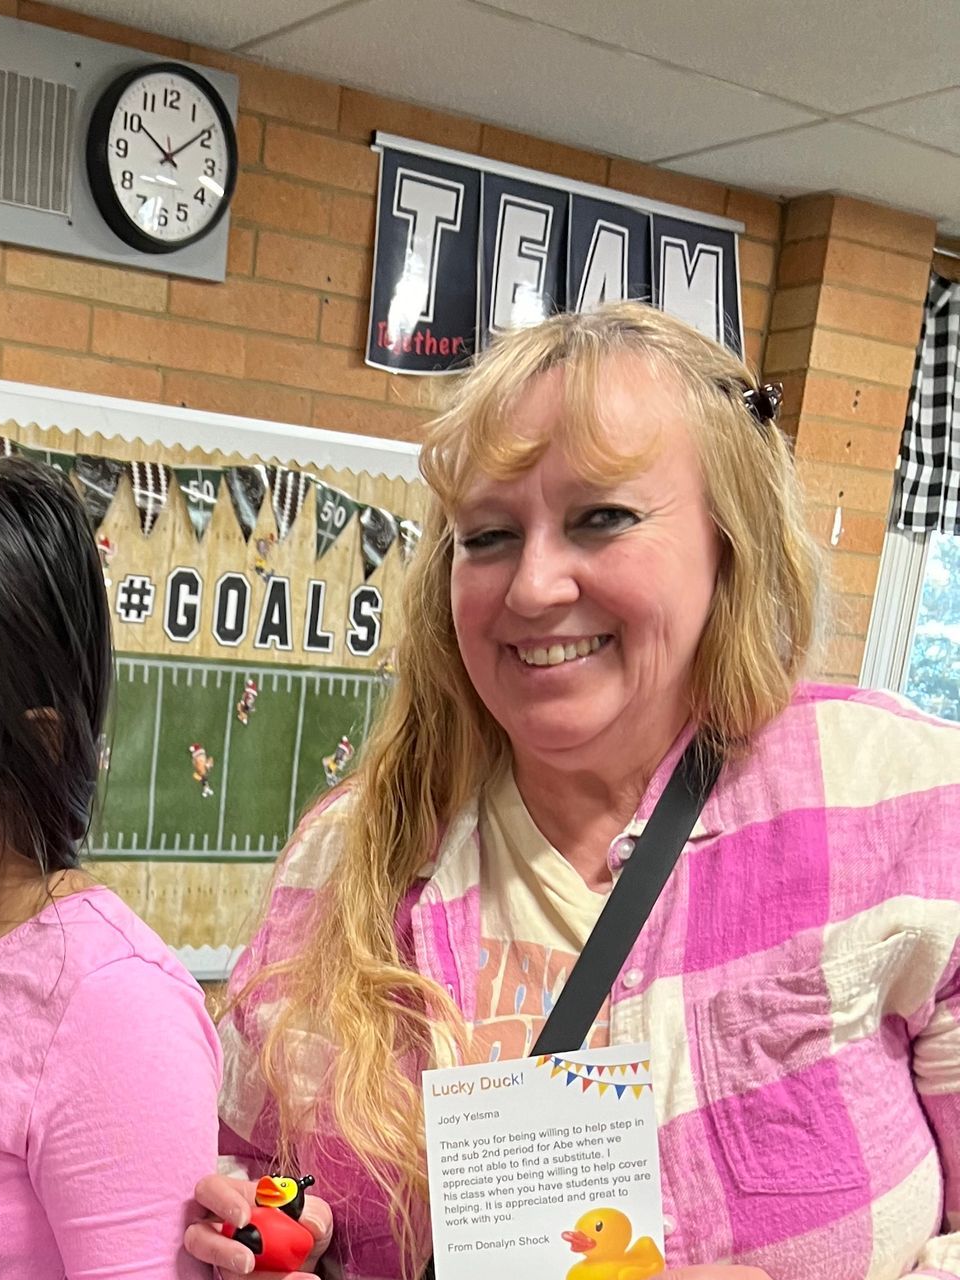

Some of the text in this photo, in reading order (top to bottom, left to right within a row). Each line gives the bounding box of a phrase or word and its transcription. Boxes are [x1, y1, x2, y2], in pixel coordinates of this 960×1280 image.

[143, 91, 156, 113] 11
[163, 88, 181, 110] 12
[124, 111, 142, 134] 10
[191, 103, 196, 123] 1
[115, 138, 128, 159] 9
[200, 128, 212, 149] 2
[203, 158, 216, 178] 3
[121, 170, 134, 190] 8
[193, 187, 206, 206] 4
[158, 208, 169, 227] 6
[176, 202, 188, 222] 5
[392, 166, 724, 348] TEAM
[188, 479, 215, 504] 50
[320, 502, 346, 528] 50
[114, 566, 382, 657] #GOALS
[432, 1072, 524, 1096] Lucky Duck!
[438, 1110, 500, 1126] Jody Yelsma
[440, 1118, 644, 1150] Thank you for being willing to help step in
[440, 1136, 622, 1163] and sub 2nd period for Abe when we
[442, 1167, 465, 1176] were
[468, 1164, 484, 1174] not
[486, 1161, 506, 1172] able
[510, 1160, 519, 1169] to
[522, 1157, 540, 1167] find
[552, 1151, 604, 1164] substitute.
[442, 1159, 647, 1189] appreciate you being willing to help cover
[444, 1192, 458, 1202] his
[460, 1190, 485, 1200] class
[488, 1188, 514, 1196] when
[517, 1185, 535, 1196] you
[538, 1182, 563, 1191] have
[566, 1177, 609, 1188] students
[612, 1176, 631, 1186] you
[444, 1188, 628, 1214] helping. It is appreciated and great to
[445, 1213, 515, 1226] work with you.
[448, 1234, 550, 1252] From Donalyn Shock
